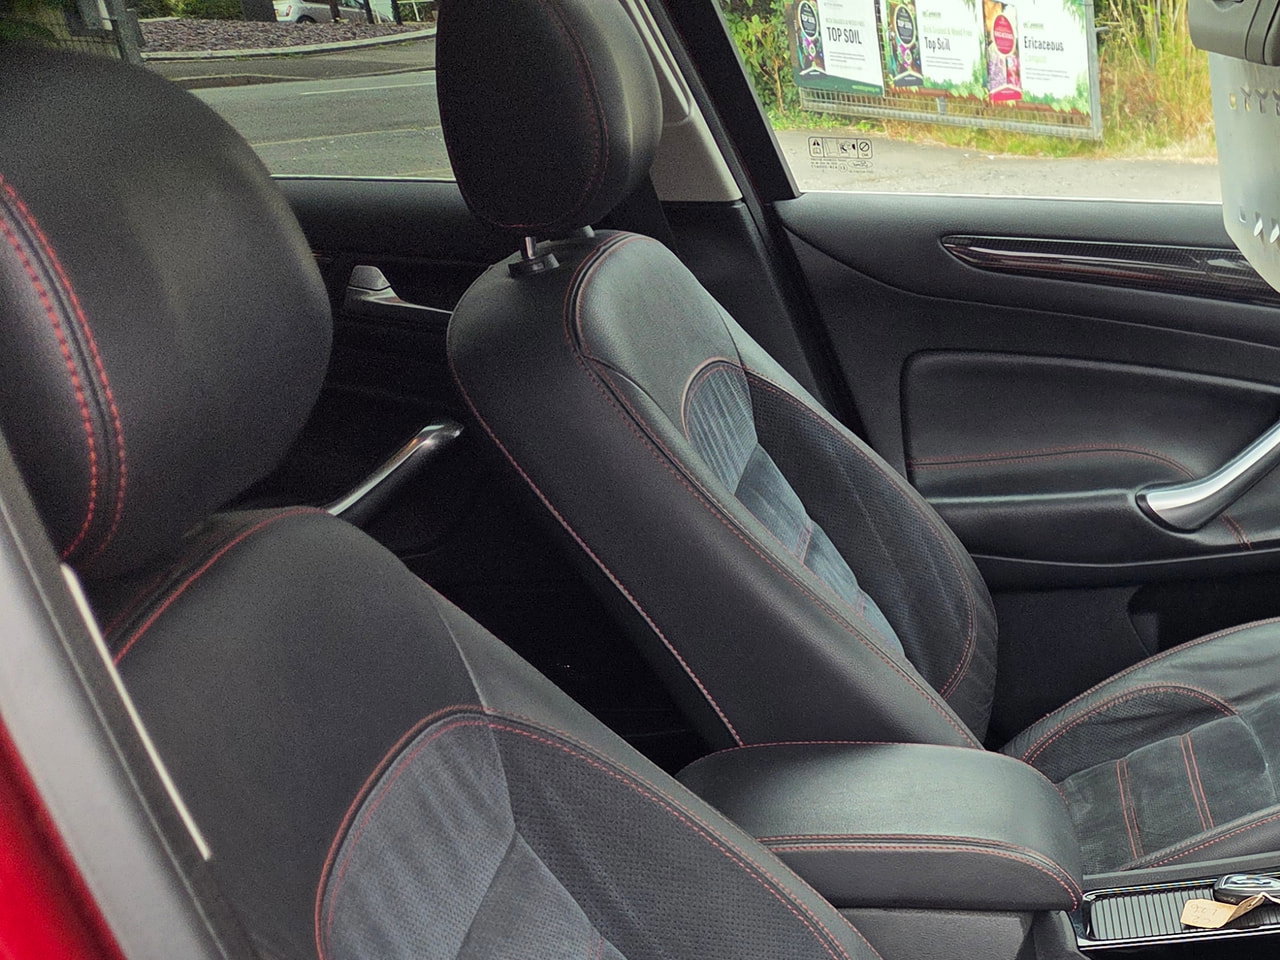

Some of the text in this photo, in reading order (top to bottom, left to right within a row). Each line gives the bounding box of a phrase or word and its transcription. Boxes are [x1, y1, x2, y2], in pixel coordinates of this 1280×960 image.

[827, 27, 862, 45] TOP SOIL
[924, 36, 950, 53] Top Soil
[1023, 36, 1064, 52] Ericaceous
